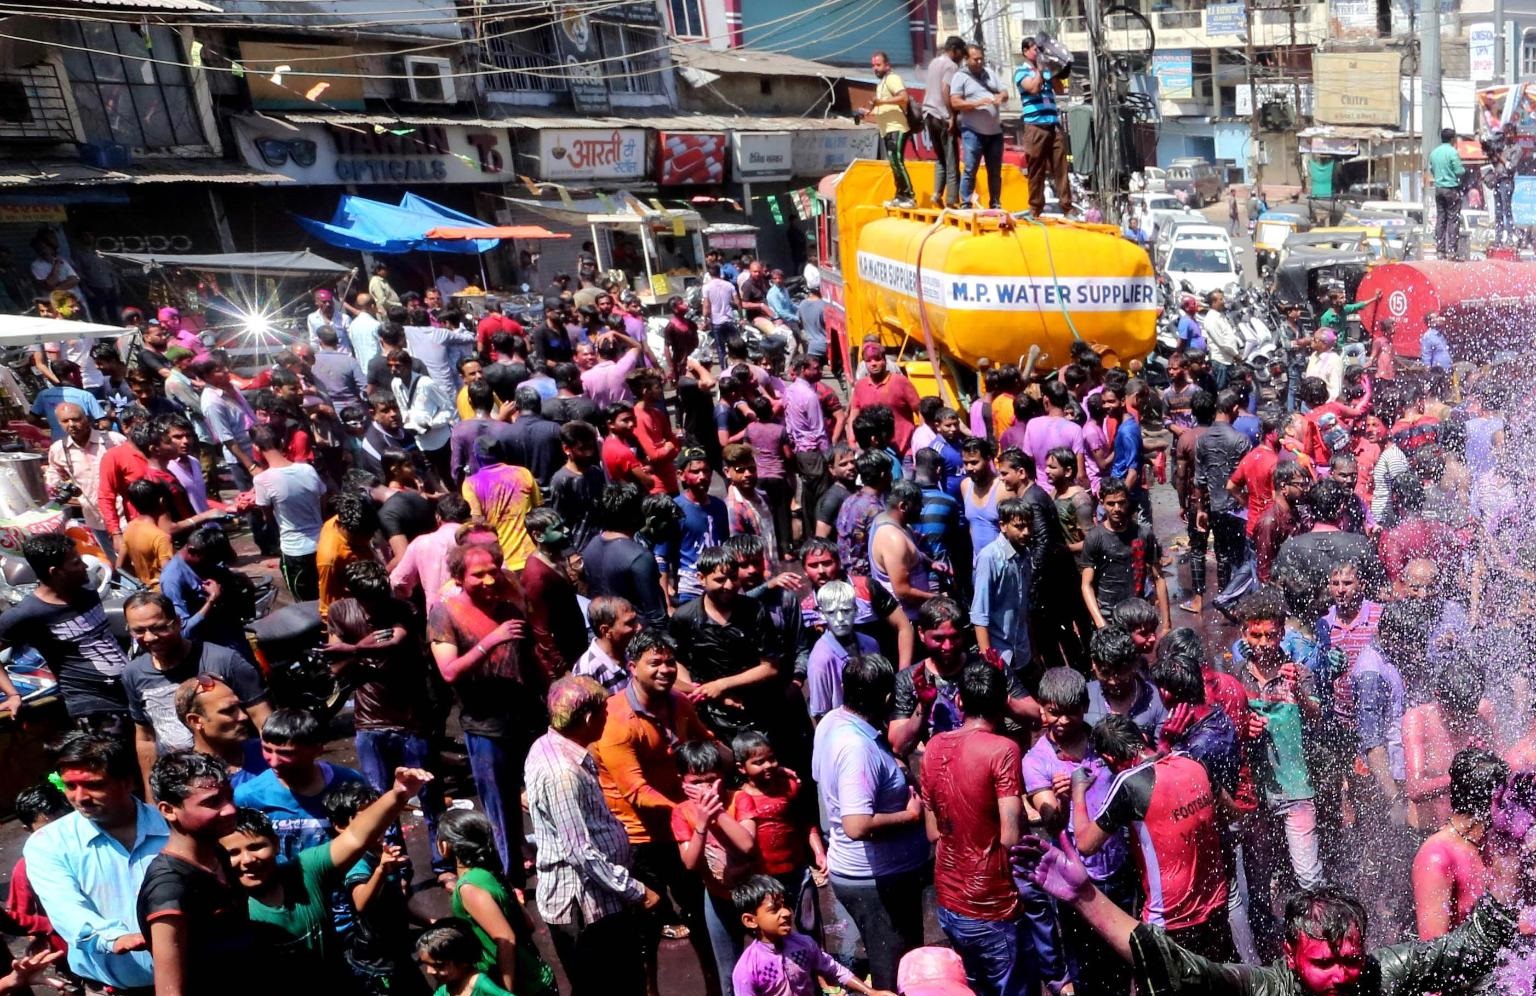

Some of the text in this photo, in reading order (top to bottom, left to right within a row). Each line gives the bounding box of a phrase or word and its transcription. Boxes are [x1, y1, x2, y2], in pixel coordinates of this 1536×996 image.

[567, 130, 622, 168] आरती
[335, 159, 447, 181] OPTICALS
[952, 282, 991, 303] M.P.
[996, 284, 1071, 304] WATER
[1077, 284, 1154, 304] SUPPLIER
[1391, 295, 1404, 314] 15
